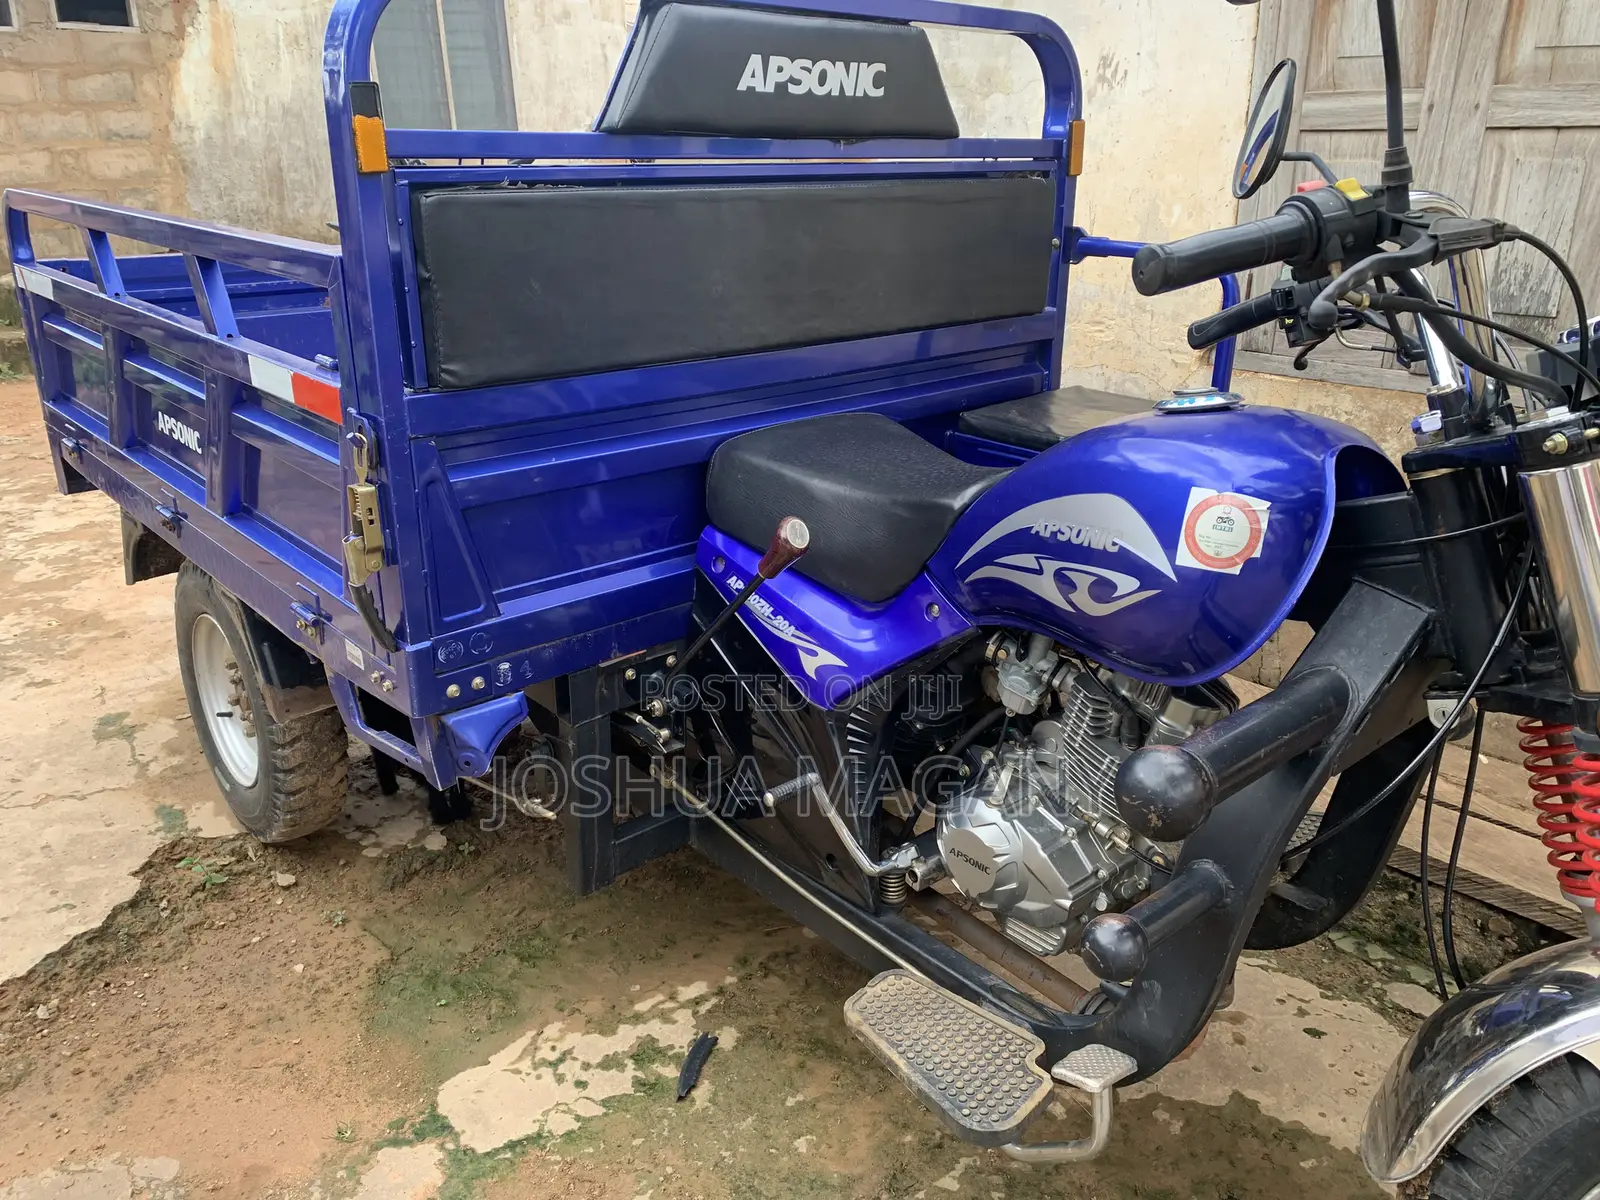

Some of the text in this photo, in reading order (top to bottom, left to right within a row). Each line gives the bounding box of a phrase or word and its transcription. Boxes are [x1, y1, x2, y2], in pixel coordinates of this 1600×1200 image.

[736, 53, 887, 97] APSONIC
[157, 410, 202, 455] APSONIC
[1030, 519, 1122, 553] APSONIC
[726, 575, 796, 637] AP0ZH-20A
[949, 847, 991, 876] APSONIC
